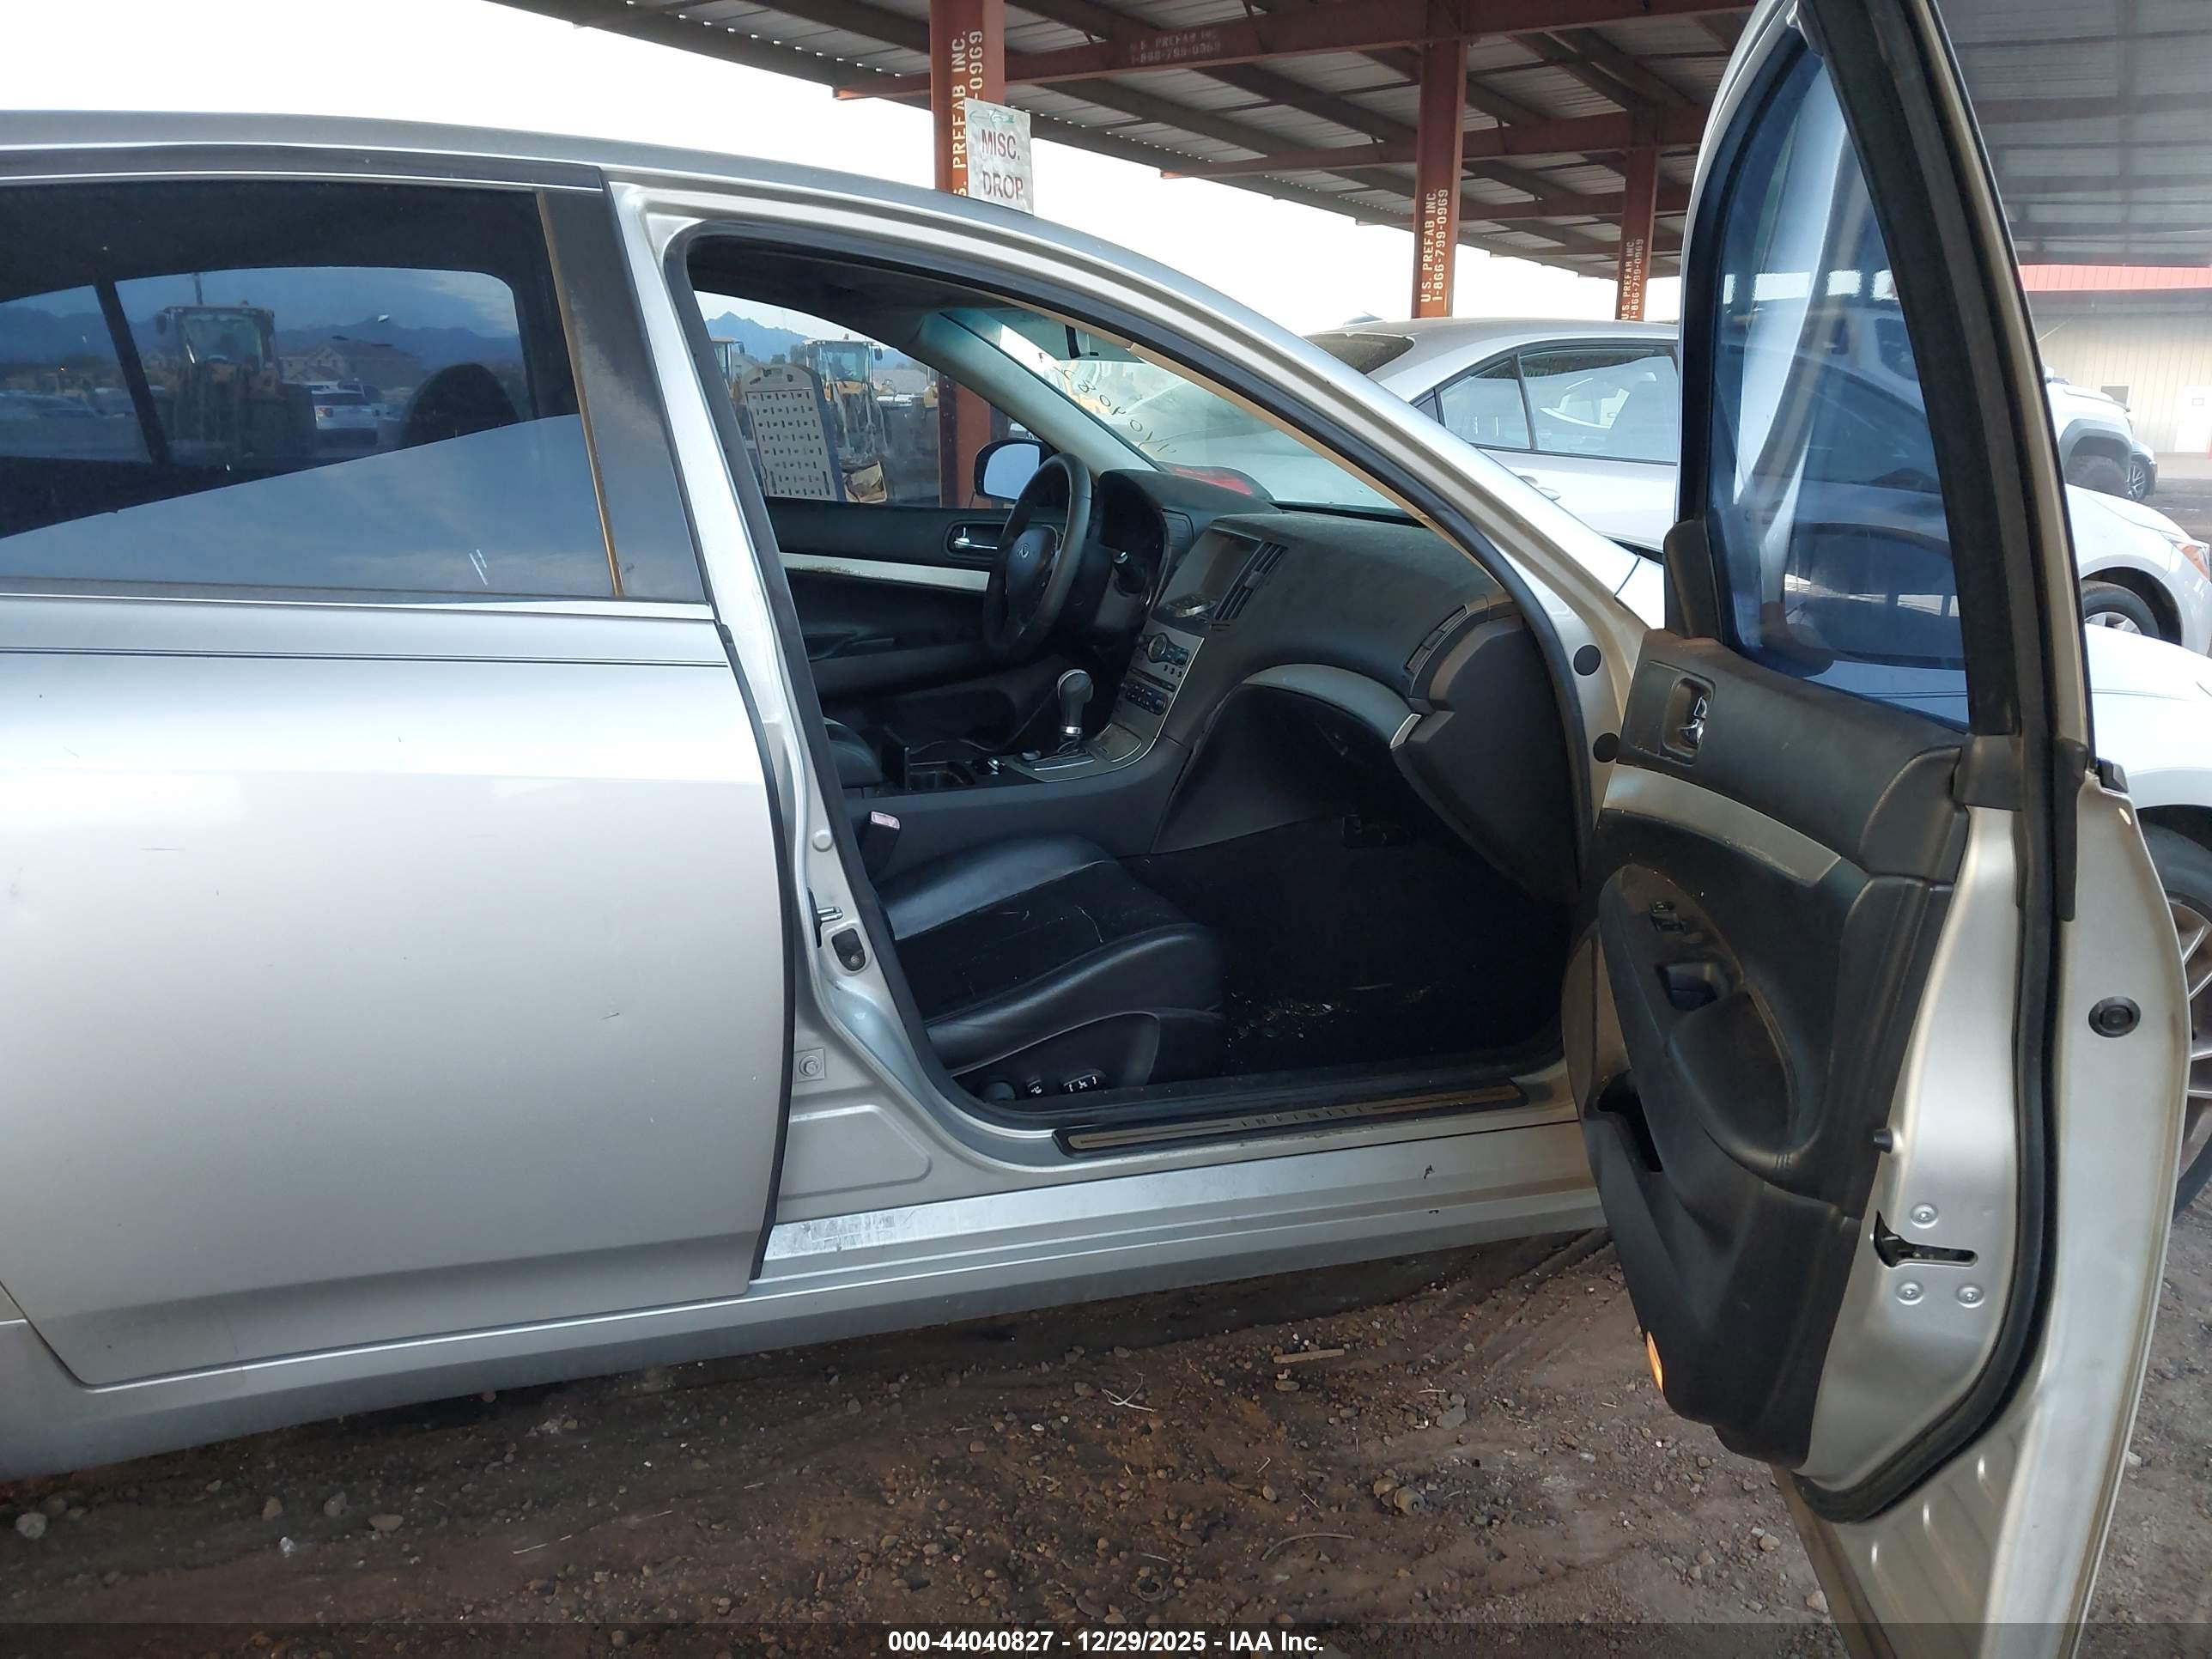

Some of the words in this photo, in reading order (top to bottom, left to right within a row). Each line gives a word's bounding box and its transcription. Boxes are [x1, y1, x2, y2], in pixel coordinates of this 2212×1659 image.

[951, 30, 966, 72] INC.
[952, 84, 967, 168] PREFAB
[981, 129, 1020, 161] MISC.
[982, 171, 1024, 200] DROP
[1422, 220, 1435, 270] PREFAB
[1432, 189, 1449, 301] 1-866-799-0969
[1420, 277, 1432, 302] U.S.
